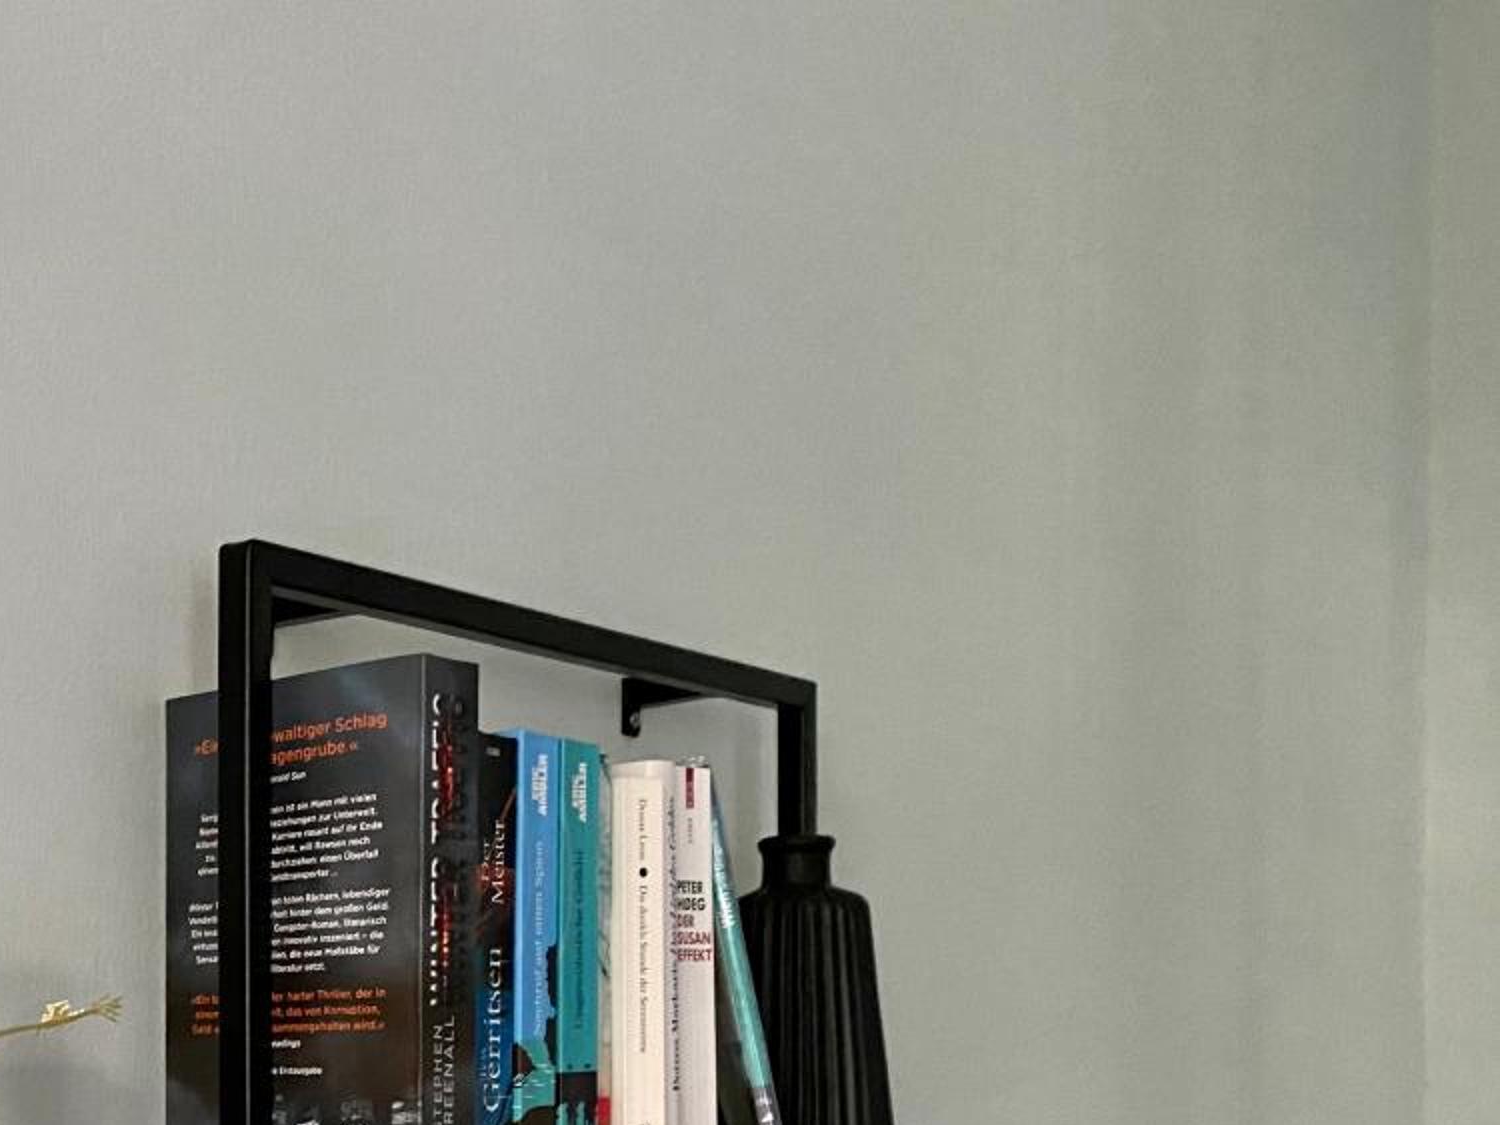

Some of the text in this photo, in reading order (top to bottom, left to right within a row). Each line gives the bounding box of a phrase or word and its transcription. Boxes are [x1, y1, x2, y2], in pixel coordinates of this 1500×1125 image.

[271, 721, 331, 743] waltiger
[335, 711, 388, 733] Schlag
[270, 740, 357, 767] gengrube.«
[359, 821, 383, 831] Ende
[344, 848, 379, 861] Überfall
[481, 837, 491, 881] Der
[491, 818, 506, 904] Meister
[676, 880, 703, 895] PETER
[676, 930, 711, 945] SUSAN
[677, 948, 713, 962] EFFEKT
[483, 948, 502, 1113] Gerritsen
